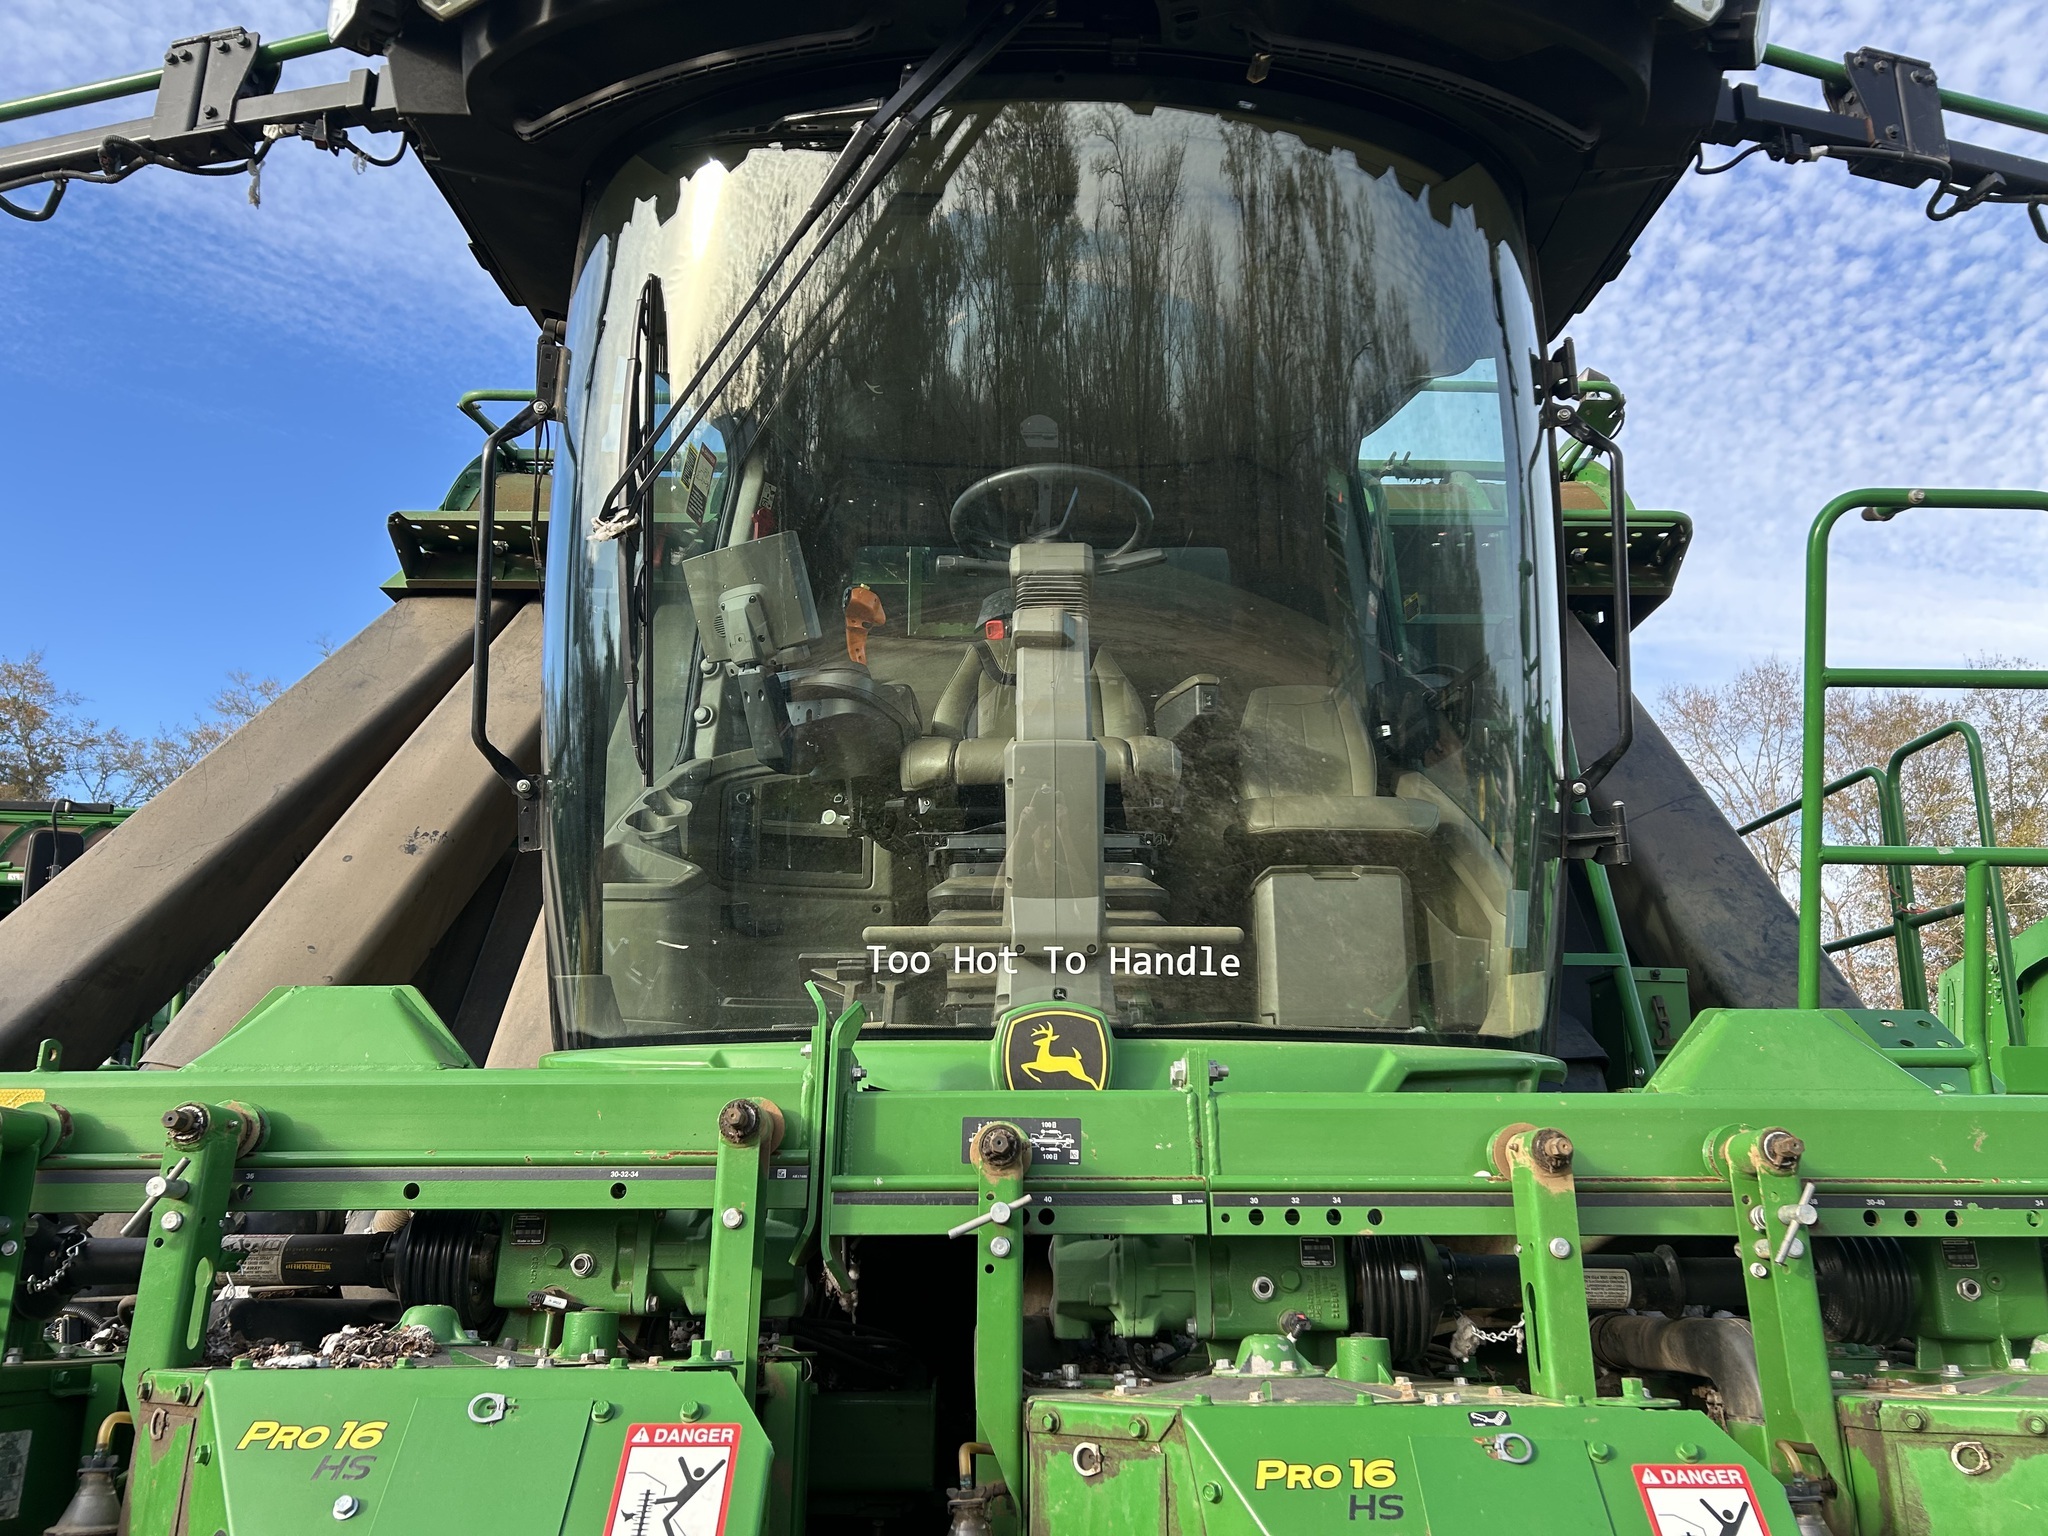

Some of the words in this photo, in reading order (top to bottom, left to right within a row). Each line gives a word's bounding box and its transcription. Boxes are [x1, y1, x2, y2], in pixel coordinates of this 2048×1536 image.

[866, 945, 931, 974] Too
[954, 945, 1018, 974] Hot
[1043, 945, 1086, 974] To
[1110, 945, 1240, 977] Handle
[1332, 1196, 1341, 1204] 34
[1954, 1199, 1963, 1207] 32
[2035, 1199, 2044, 1207] 34
[333, 1420, 390, 1450] 16
[653, 1428, 734, 1443] DANGER
[310, 1455, 377, 1480] HS
[1349, 1458, 1397, 1490] 16
[1660, 1469, 1744, 1485] DANGER
[1349, 1494, 1404, 1520] HS
